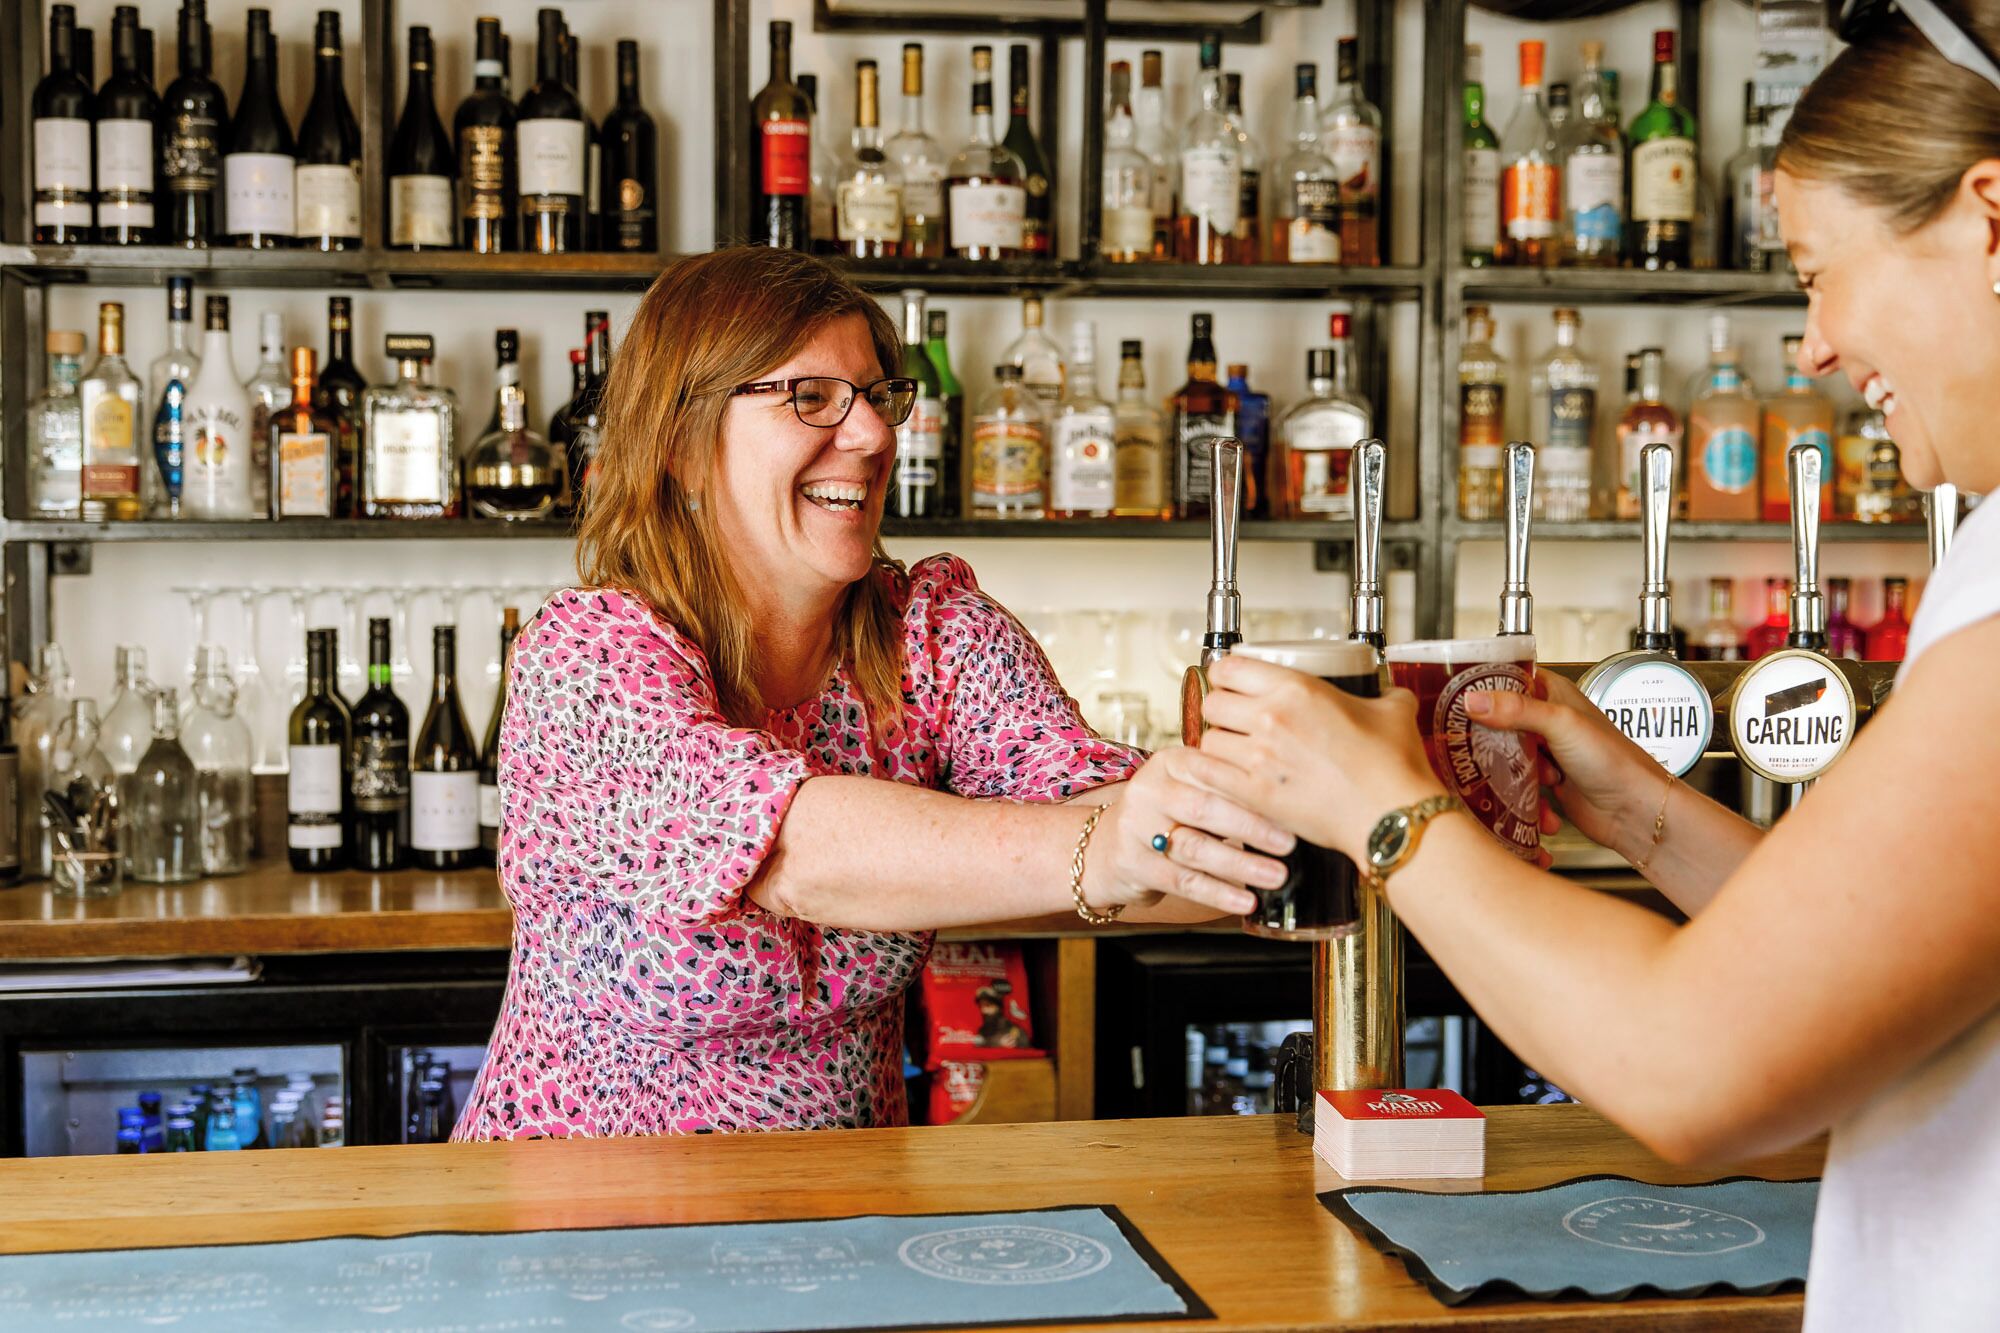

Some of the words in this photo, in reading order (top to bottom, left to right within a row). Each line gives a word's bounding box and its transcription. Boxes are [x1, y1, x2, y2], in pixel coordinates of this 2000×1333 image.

[1746, 715, 1842, 745] CARLING
[1450, 746, 1479, 784] HOOK
[931, 944, 1005, 965] REAL
